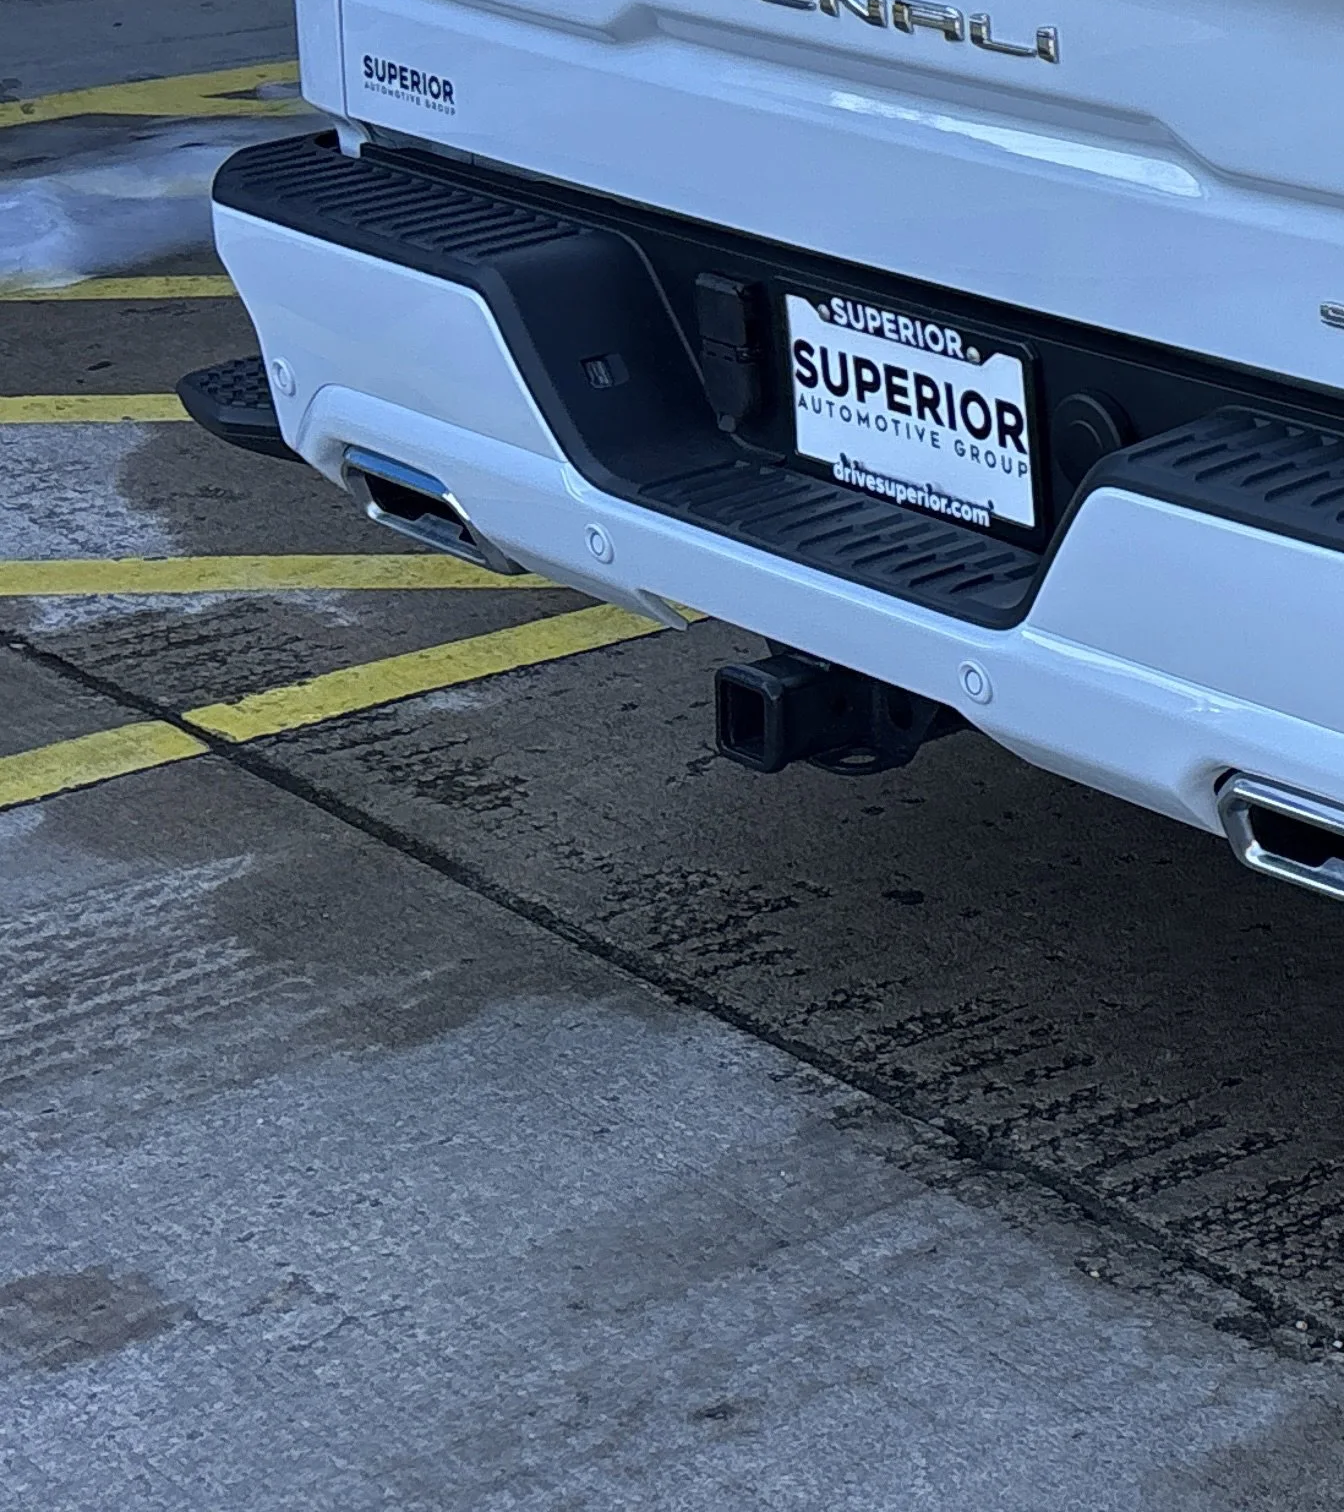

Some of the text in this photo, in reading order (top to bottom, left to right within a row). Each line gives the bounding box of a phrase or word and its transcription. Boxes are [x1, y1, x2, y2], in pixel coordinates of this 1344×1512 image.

[362, 54, 455, 105] SUPERIOR
[364, 81, 421, 106] AUTOMOTIVE
[830, 296, 965, 361] SUPERIOR
[793, 338, 1029, 456] SUPERIOR
[797, 392, 1029, 479] AUTOMOTIVE GROUP
[832, 460, 991, 528] drivesuperior.com
